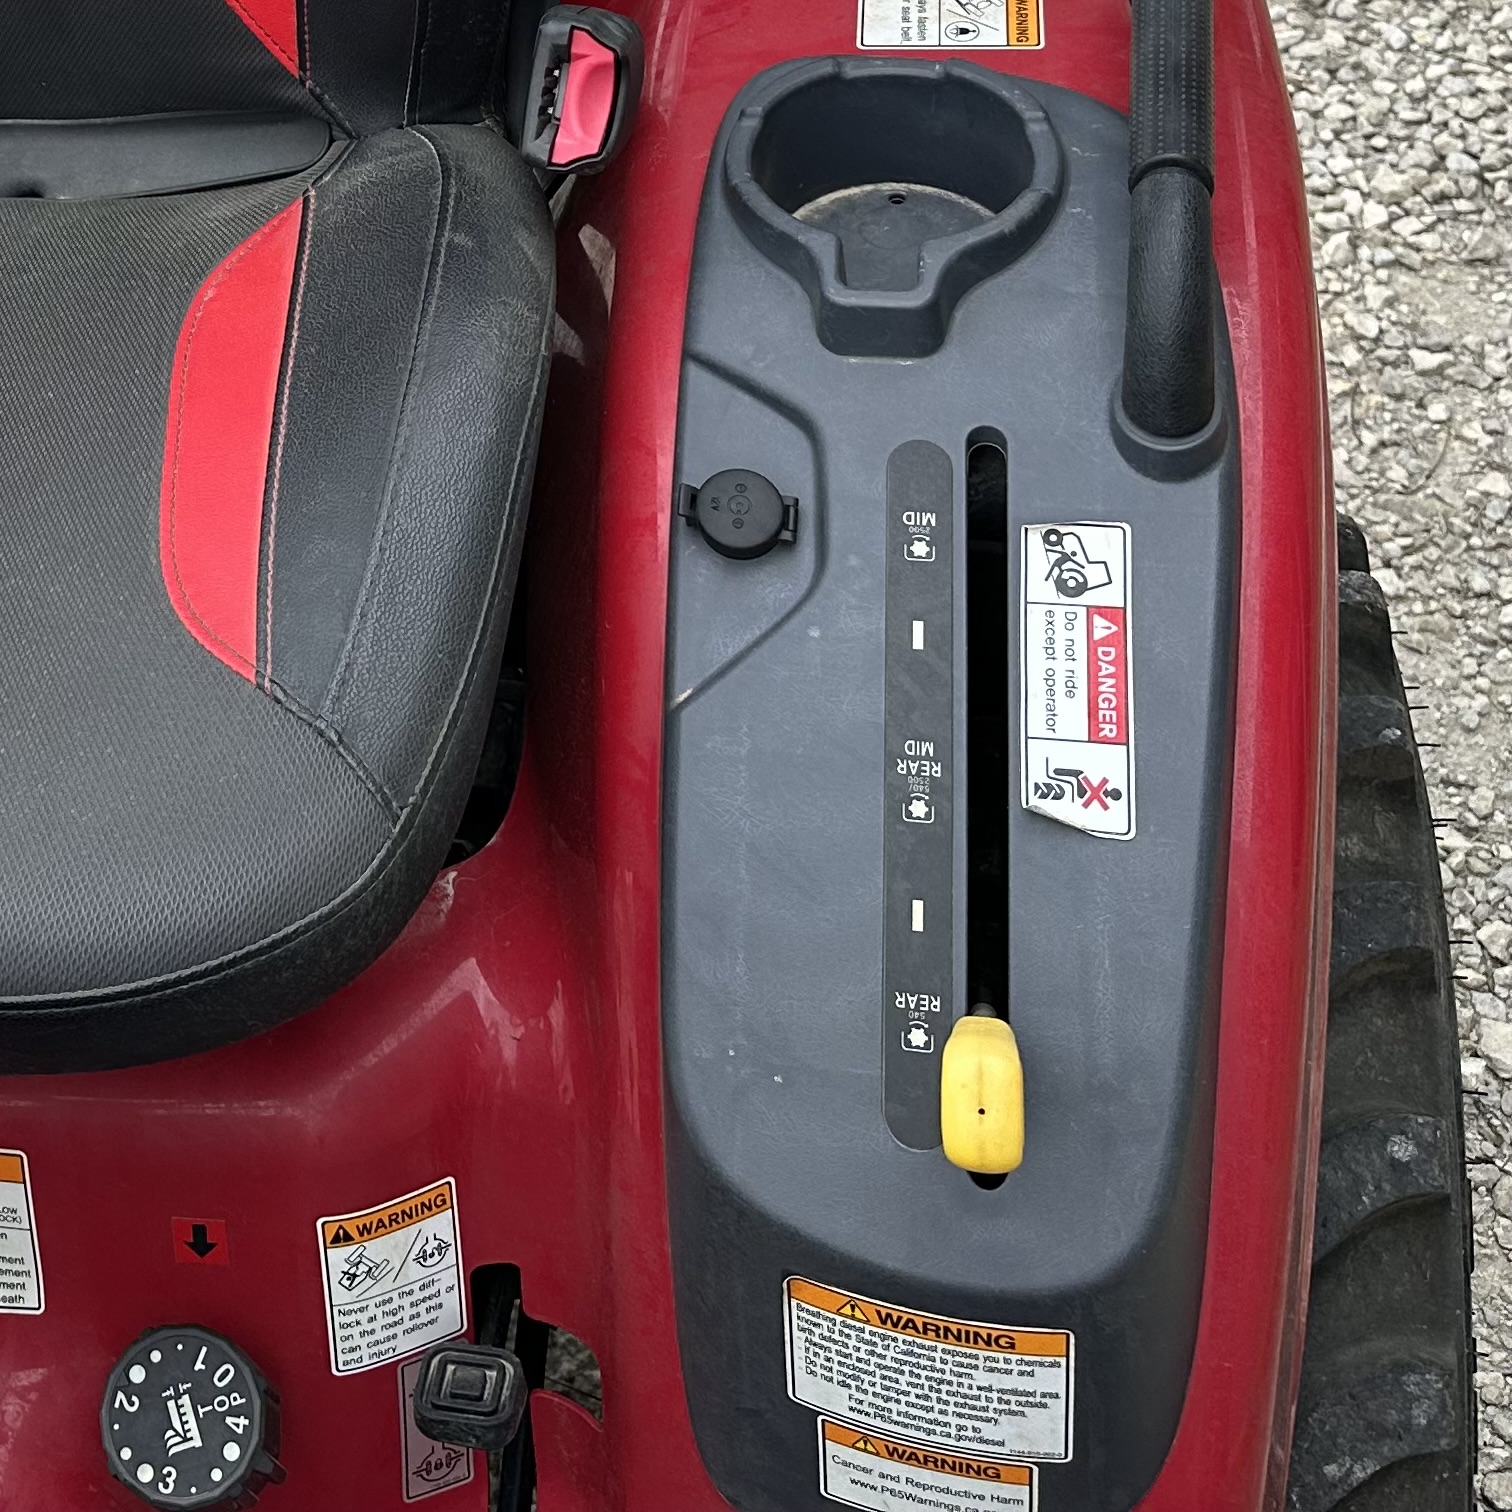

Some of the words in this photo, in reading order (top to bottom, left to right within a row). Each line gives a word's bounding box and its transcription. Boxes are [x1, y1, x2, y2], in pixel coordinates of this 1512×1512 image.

[902, 512, 936, 526] MID
[908, 526, 930, 534] 2500
[1064, 611, 1078, 631] Do
[1043, 610, 1058, 661] except
[1064, 638, 1077, 662] not
[1064, 670, 1080, 699] ride
[1097, 646, 1117, 738] DANGER
[1043, 668, 1058, 734] operator
[904, 740, 934, 757] MID
[896, 758, 942, 778] REAR
[908, 776, 930, 785] 2500
[895, 992, 940, 1012] REAR
[908, 1010, 926, 1020] 540
[356, 1192, 447, 1238] WARNING
[338, 1304, 370, 1317] Never
[374, 1296, 394, 1308] use
[398, 1288, 414, 1300] the
[339, 1319, 362, 1330] lock
[367, 1314, 377, 1324] at
[382, 1304, 405, 1319] high
[410, 1288, 441, 1309] speed
[445, 1284, 455, 1294] or
[340, 1334, 354, 1342] on
[359, 1328, 376, 1338] the
[381, 1316, 404, 1332] road
[408, 1311, 421, 1321] as
[425, 1302, 443, 1314] this
[875, 1309, 1016, 1351] WARNING
[341, 1344, 362, 1355] can
[366, 1332, 398, 1349] cause
[402, 1316, 439, 1336] rollover
[194, 1346, 208, 1371] 1
[342, 1354, 363, 1367] and
[368, 1345, 397, 1360] injury
[213, 1363, 235, 1387] 0
[114, 1390, 140, 1413] 2
[197, 1392, 247, 1418] TOP
[225, 1415, 250, 1434] 4
[884, 1444, 1001, 1480] WARNING
[158, 1466, 177, 1494] 3
[832, 1454, 873, 1475] Cancer
[878, 1472, 900, 1484] and
[905, 1477, 986, 1501] Reproductive
[990, 1494, 1024, 1506] Harm
